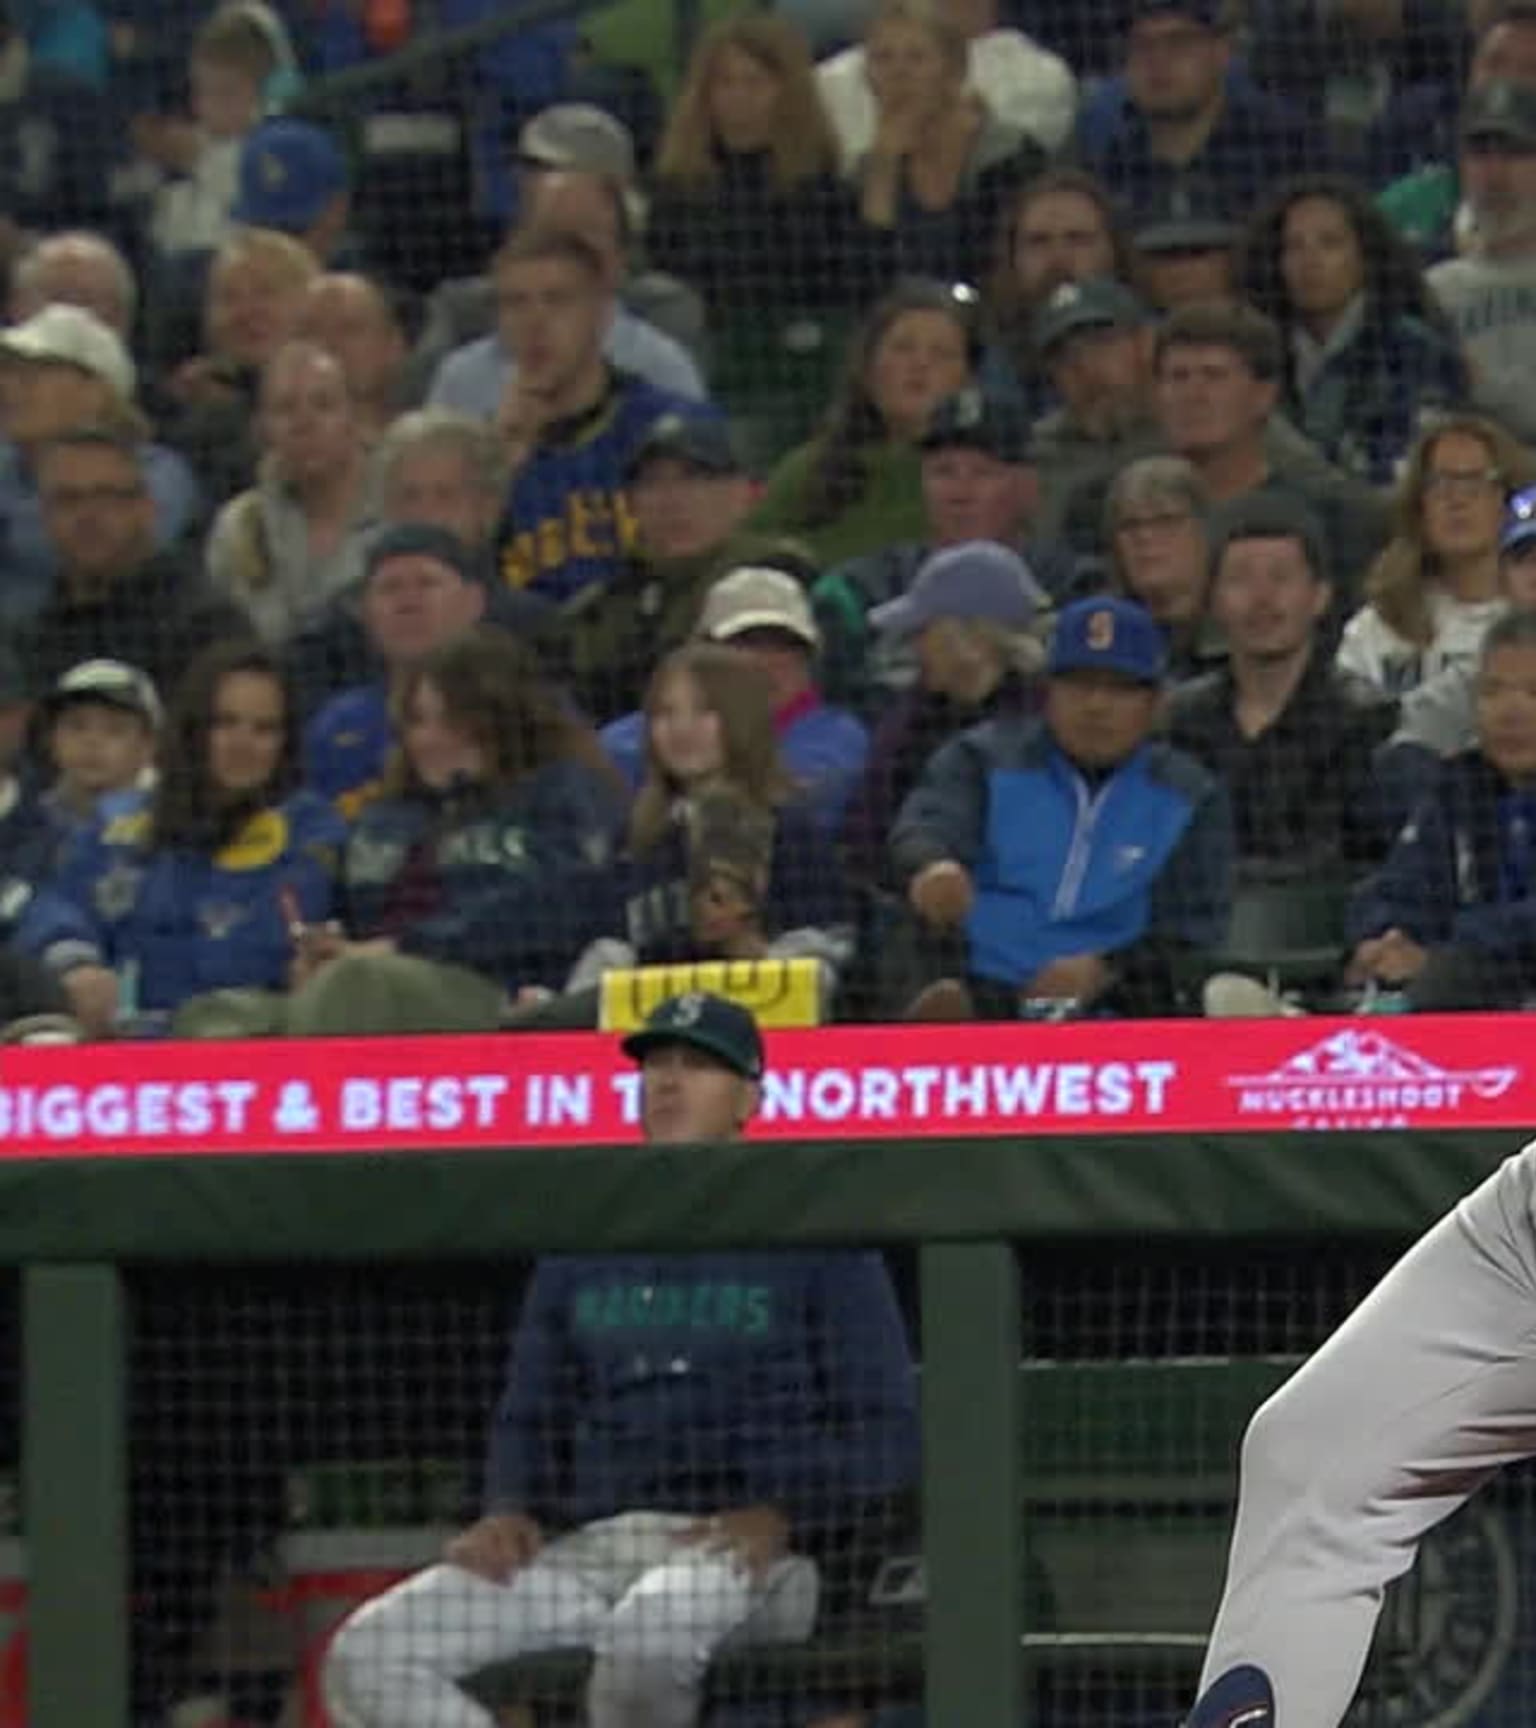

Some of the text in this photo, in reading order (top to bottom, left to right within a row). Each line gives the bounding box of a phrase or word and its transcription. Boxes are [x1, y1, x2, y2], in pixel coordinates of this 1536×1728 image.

[273, 1078, 320, 1133] &
[341, 1074, 508, 1132] BEST
[525, 1073, 592, 1127] IN
[761, 1060, 1177, 1122] NORTHWEST
